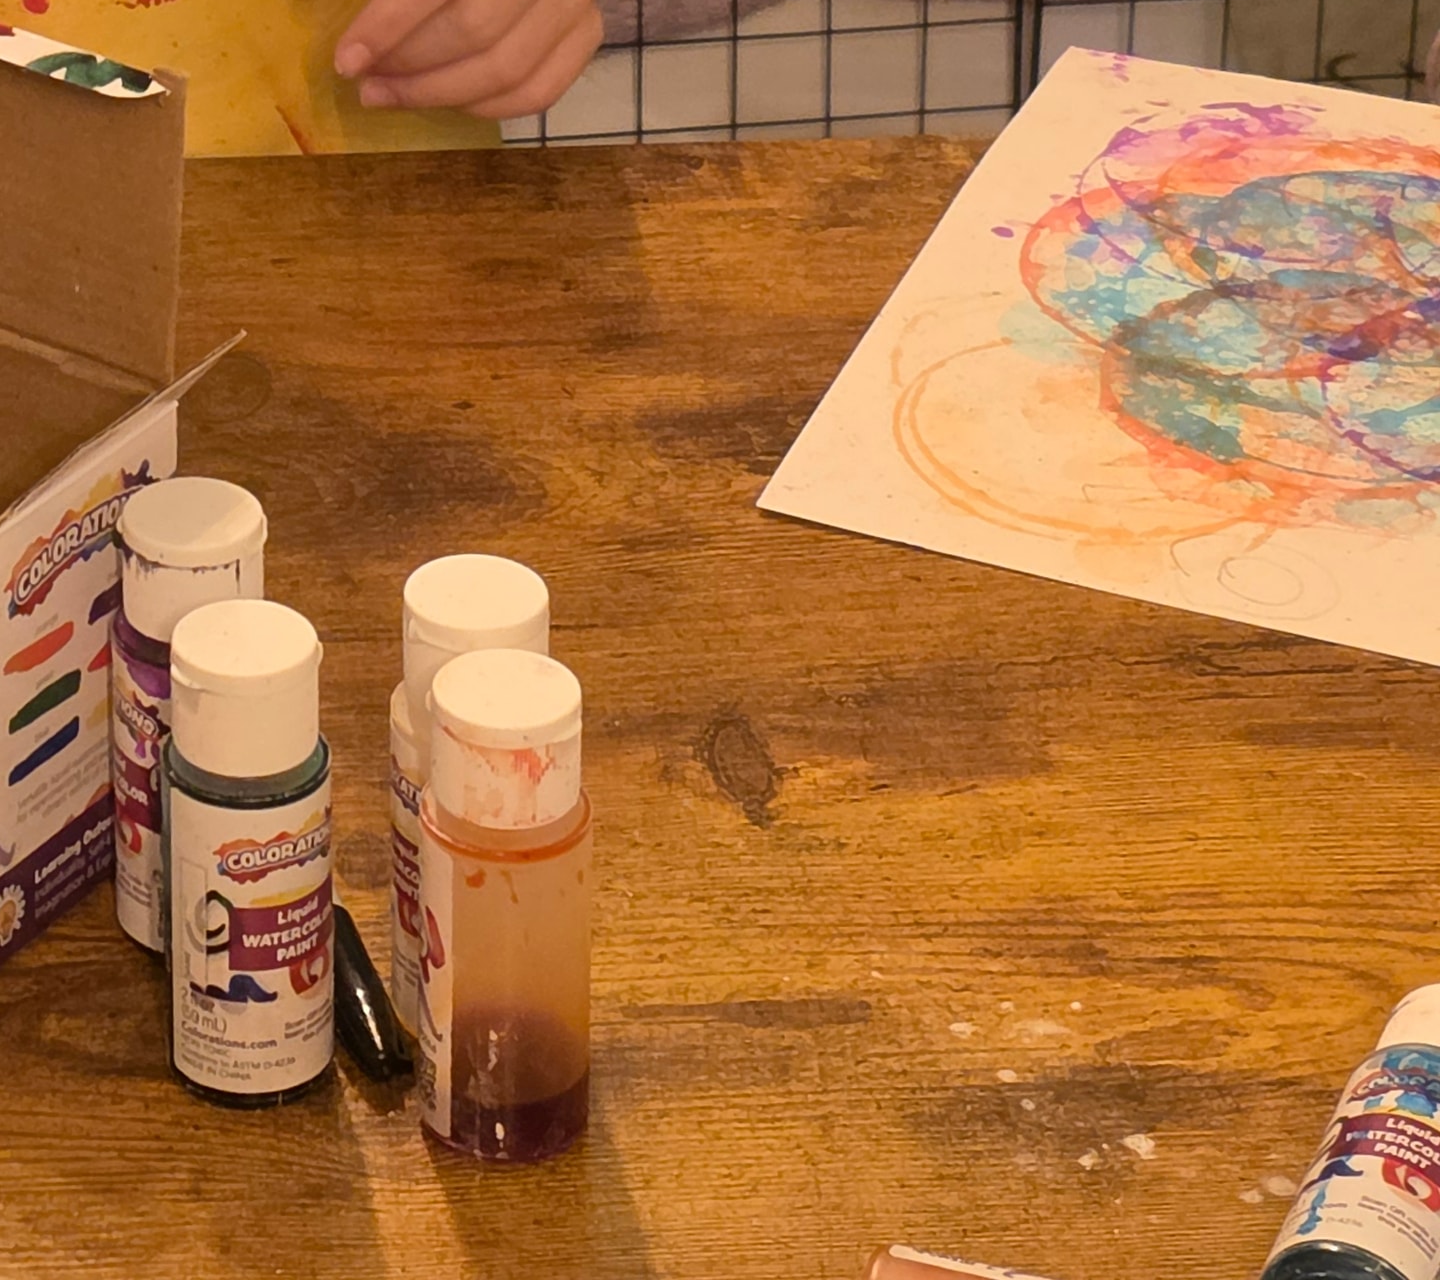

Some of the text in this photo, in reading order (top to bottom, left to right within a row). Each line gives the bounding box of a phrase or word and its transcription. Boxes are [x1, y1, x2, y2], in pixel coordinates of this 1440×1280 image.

[16, 493, 128, 601] COLORATIO
[277, 895, 319, 925] Liquid
[277, 931, 319, 963] PAINT
[181, 1020, 278, 1050] Colorations.com
[1374, 1142, 1432, 1169] PAINT
